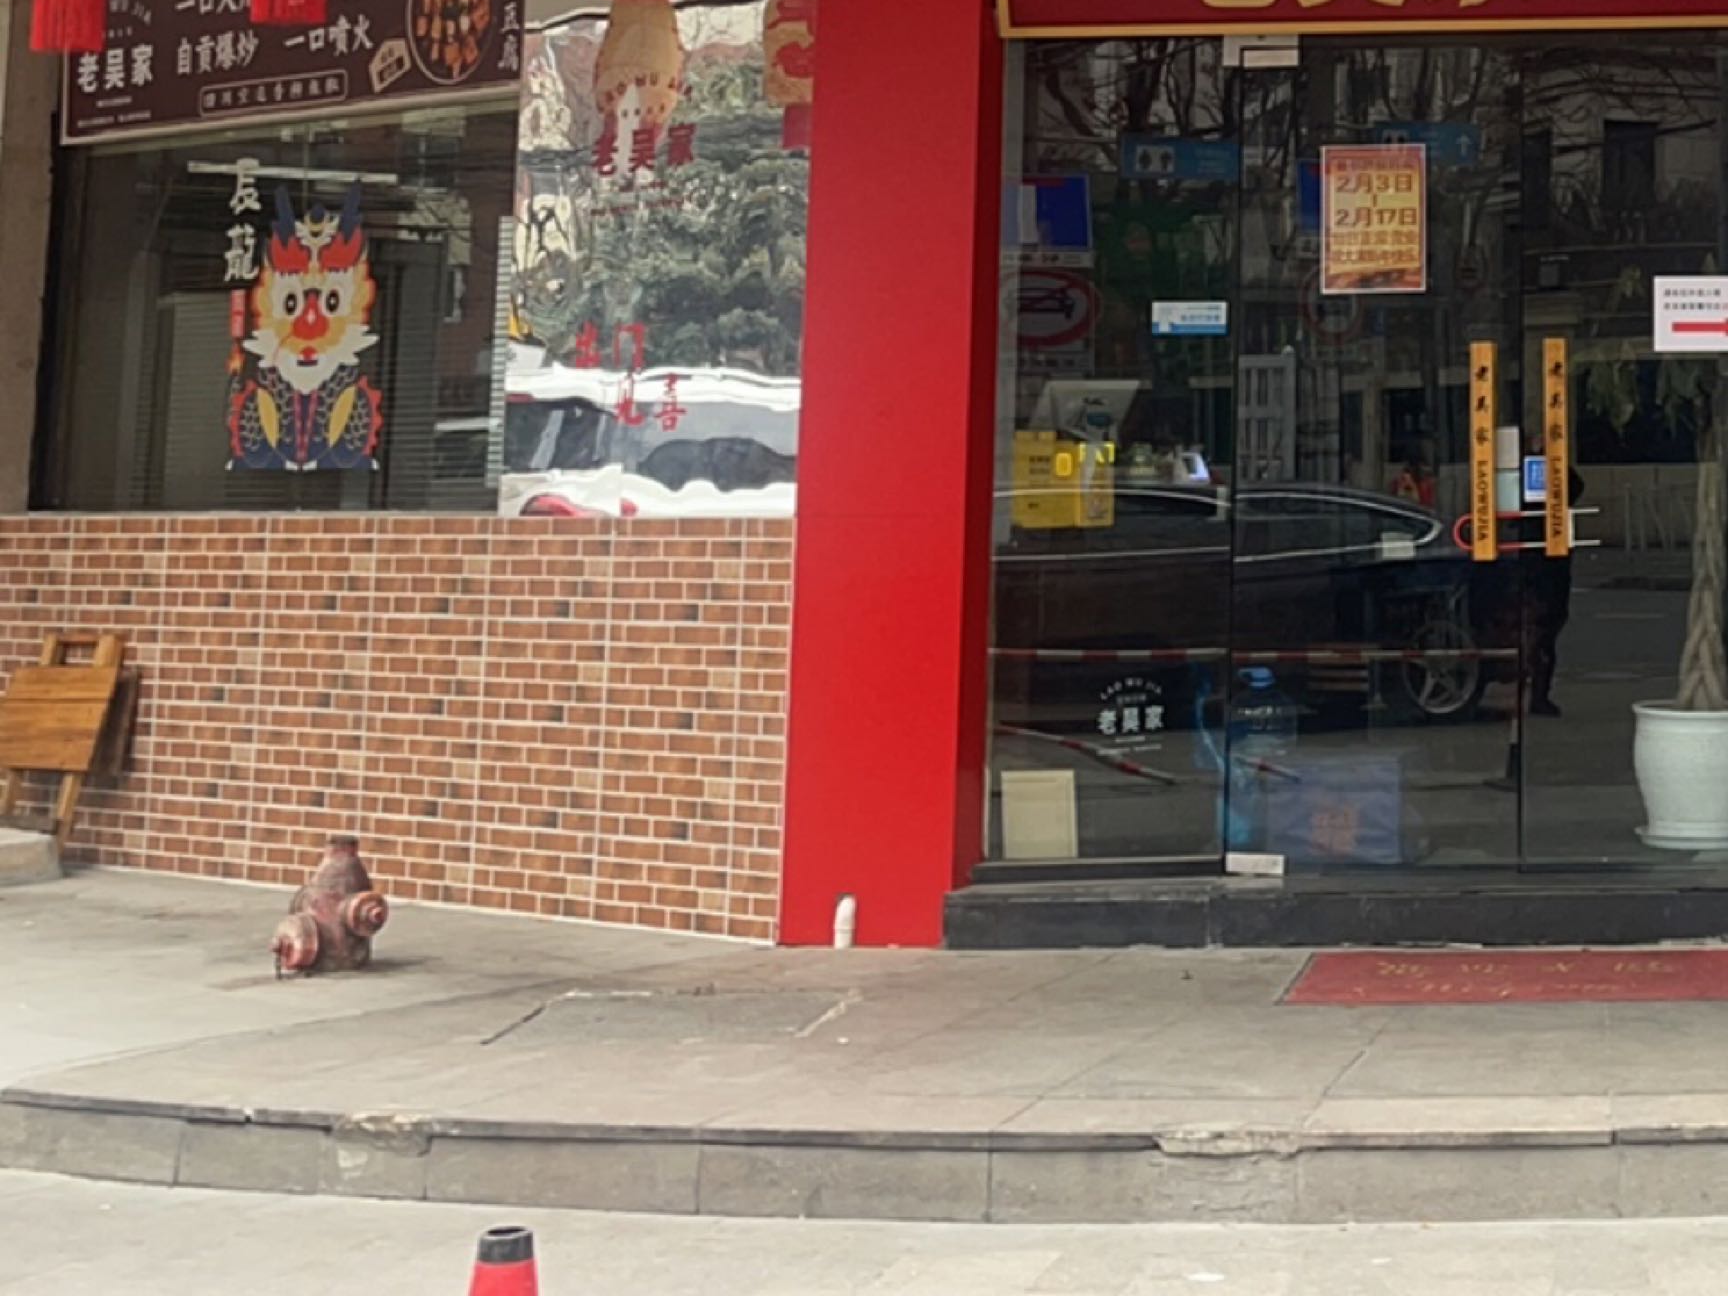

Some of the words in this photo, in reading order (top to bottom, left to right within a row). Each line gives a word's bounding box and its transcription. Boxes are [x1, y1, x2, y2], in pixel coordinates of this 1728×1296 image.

[77, 43, 153, 93] 老吴家
[591, 120, 697, 177] 老吴家
[1335, 172, 1414, 194] 2月3日
[1335, 206, 1418, 228] 2月17日
[1098, 705, 1165, 736] 老吴家
